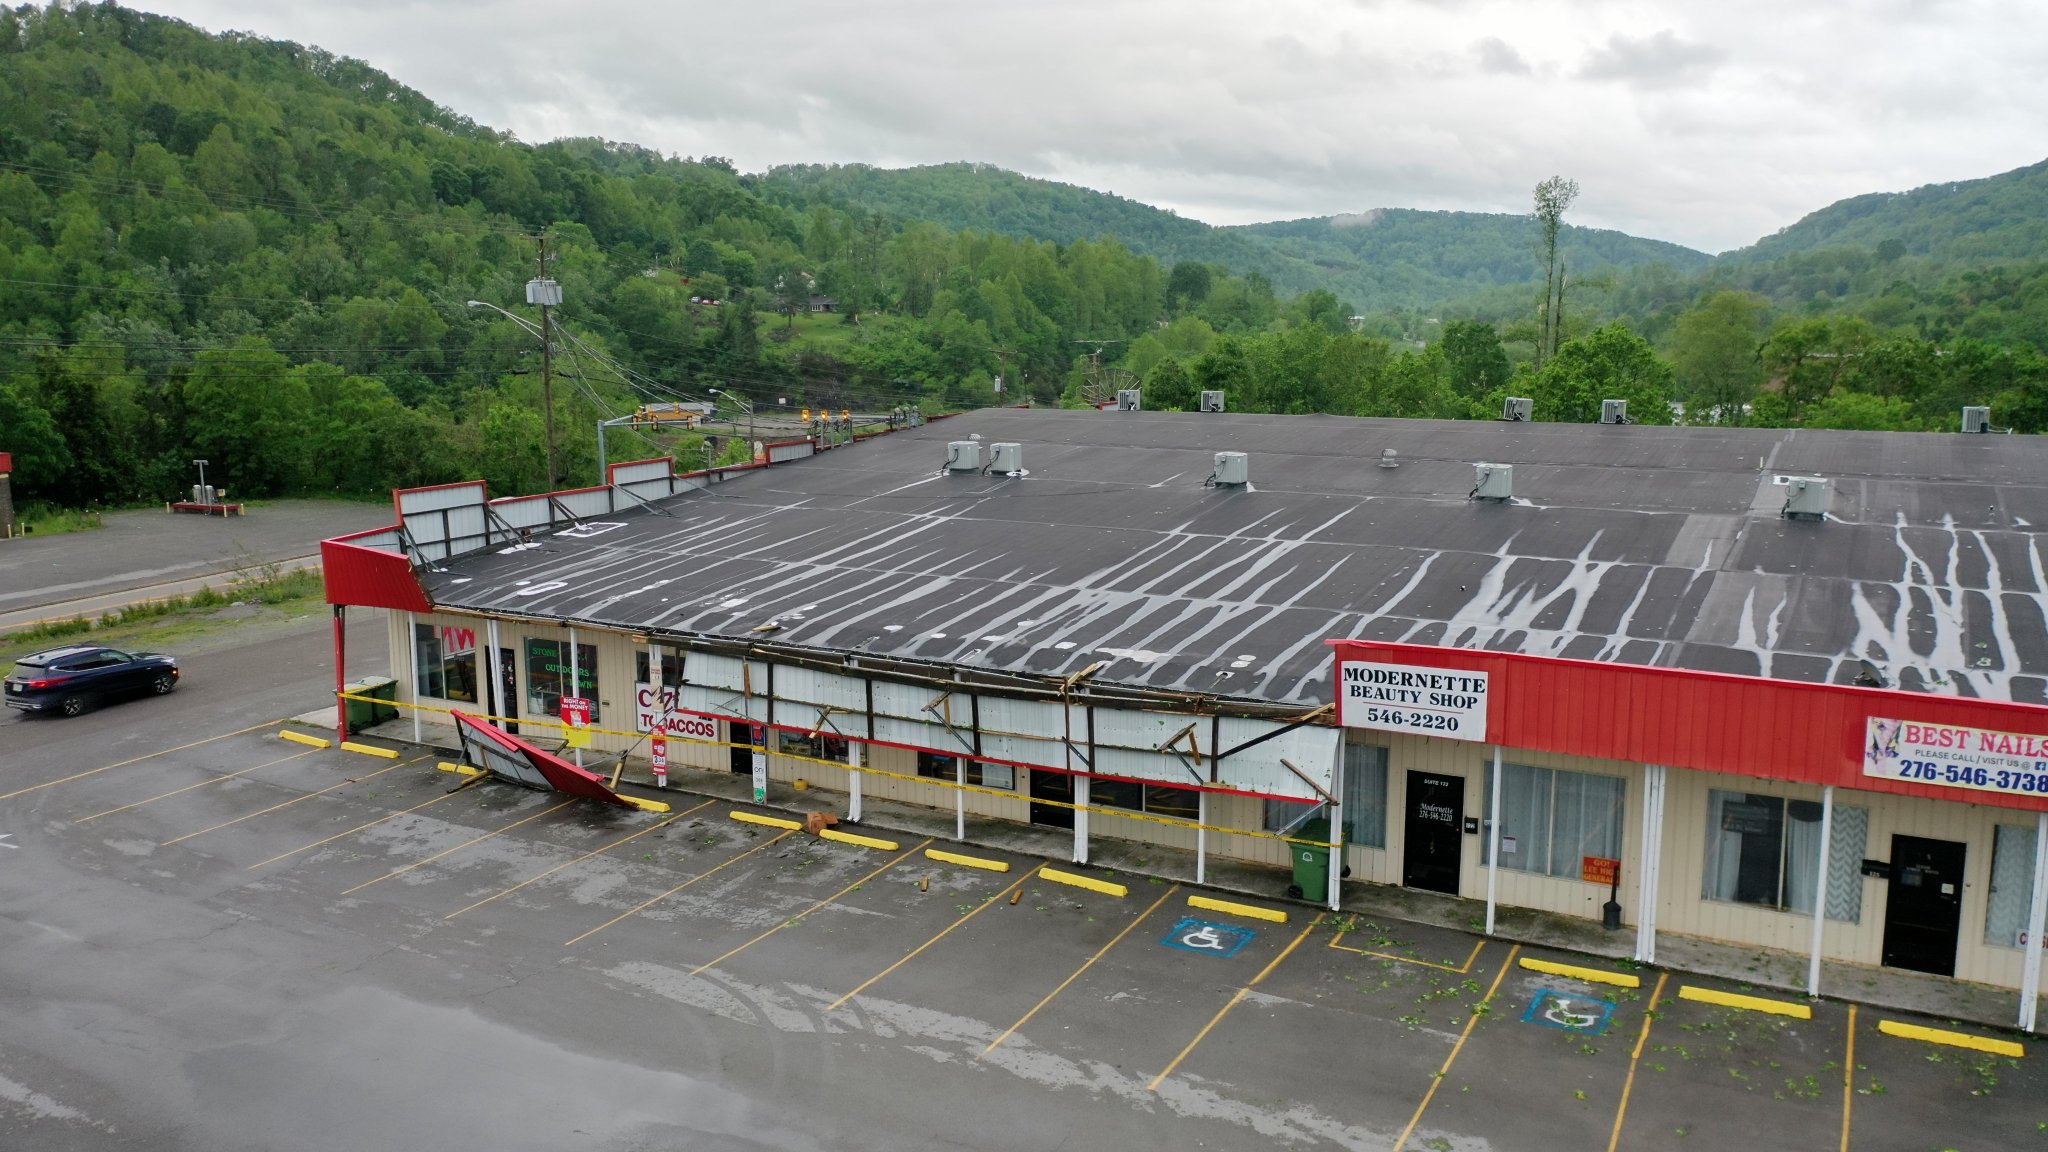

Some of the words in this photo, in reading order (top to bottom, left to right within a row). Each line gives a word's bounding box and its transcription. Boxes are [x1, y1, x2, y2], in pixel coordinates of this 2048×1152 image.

[532, 647, 558, 658] STONE
[1344, 668, 1486, 694] MODERNETTE
[1350, 684, 1422, 704] BEAUTY
[1429, 692, 1478, 710] SHOP
[1368, 708, 1459, 732] 546-2220
[1904, 724, 1971, 749] BEST
[1915, 749, 1949, 760] PLEASE
[1952, 753, 1974, 763] CALL
[1982, 756, 2004, 766] VISIT
[2006, 759, 2020, 768] US
[1899, 759, 2048, 793] 276-546-3738
[1418, 810, 1452, 822] 276-546-2220
[1584, 865, 1598, 874] LEE
